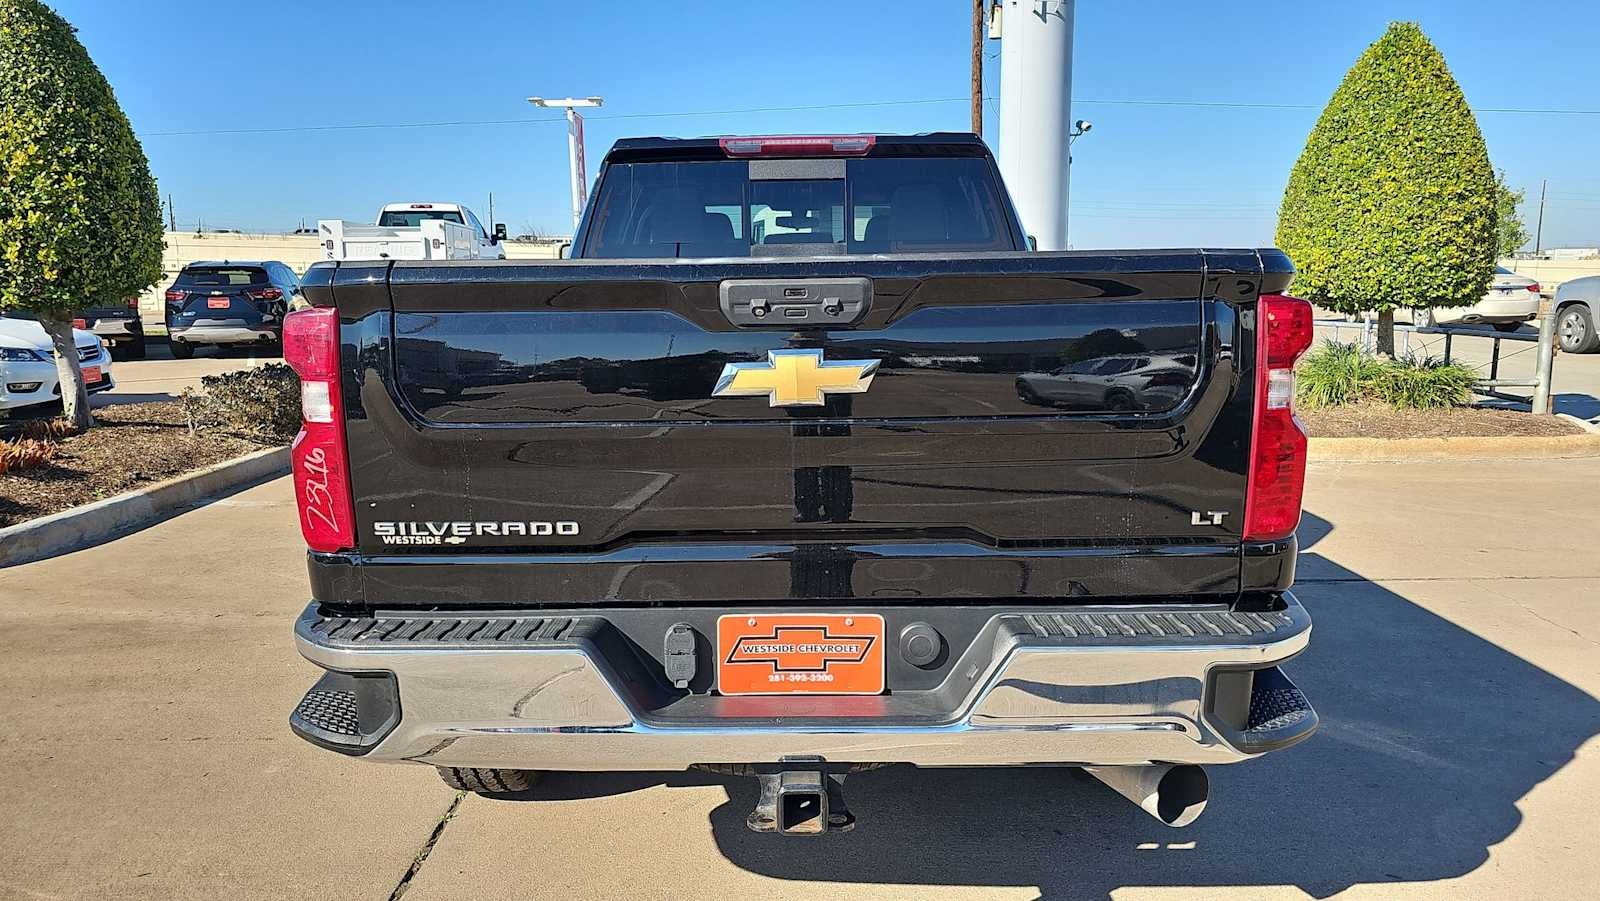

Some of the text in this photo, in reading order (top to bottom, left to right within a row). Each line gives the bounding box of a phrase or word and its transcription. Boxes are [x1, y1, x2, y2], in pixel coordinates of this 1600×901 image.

[1191, 511, 1229, 525] LT
[374, 521, 580, 536] SILVERADO
[382, 535, 442, 545] WESTSIDE
[741, 643, 861, 654] WESTSIDE CHEVROLET
